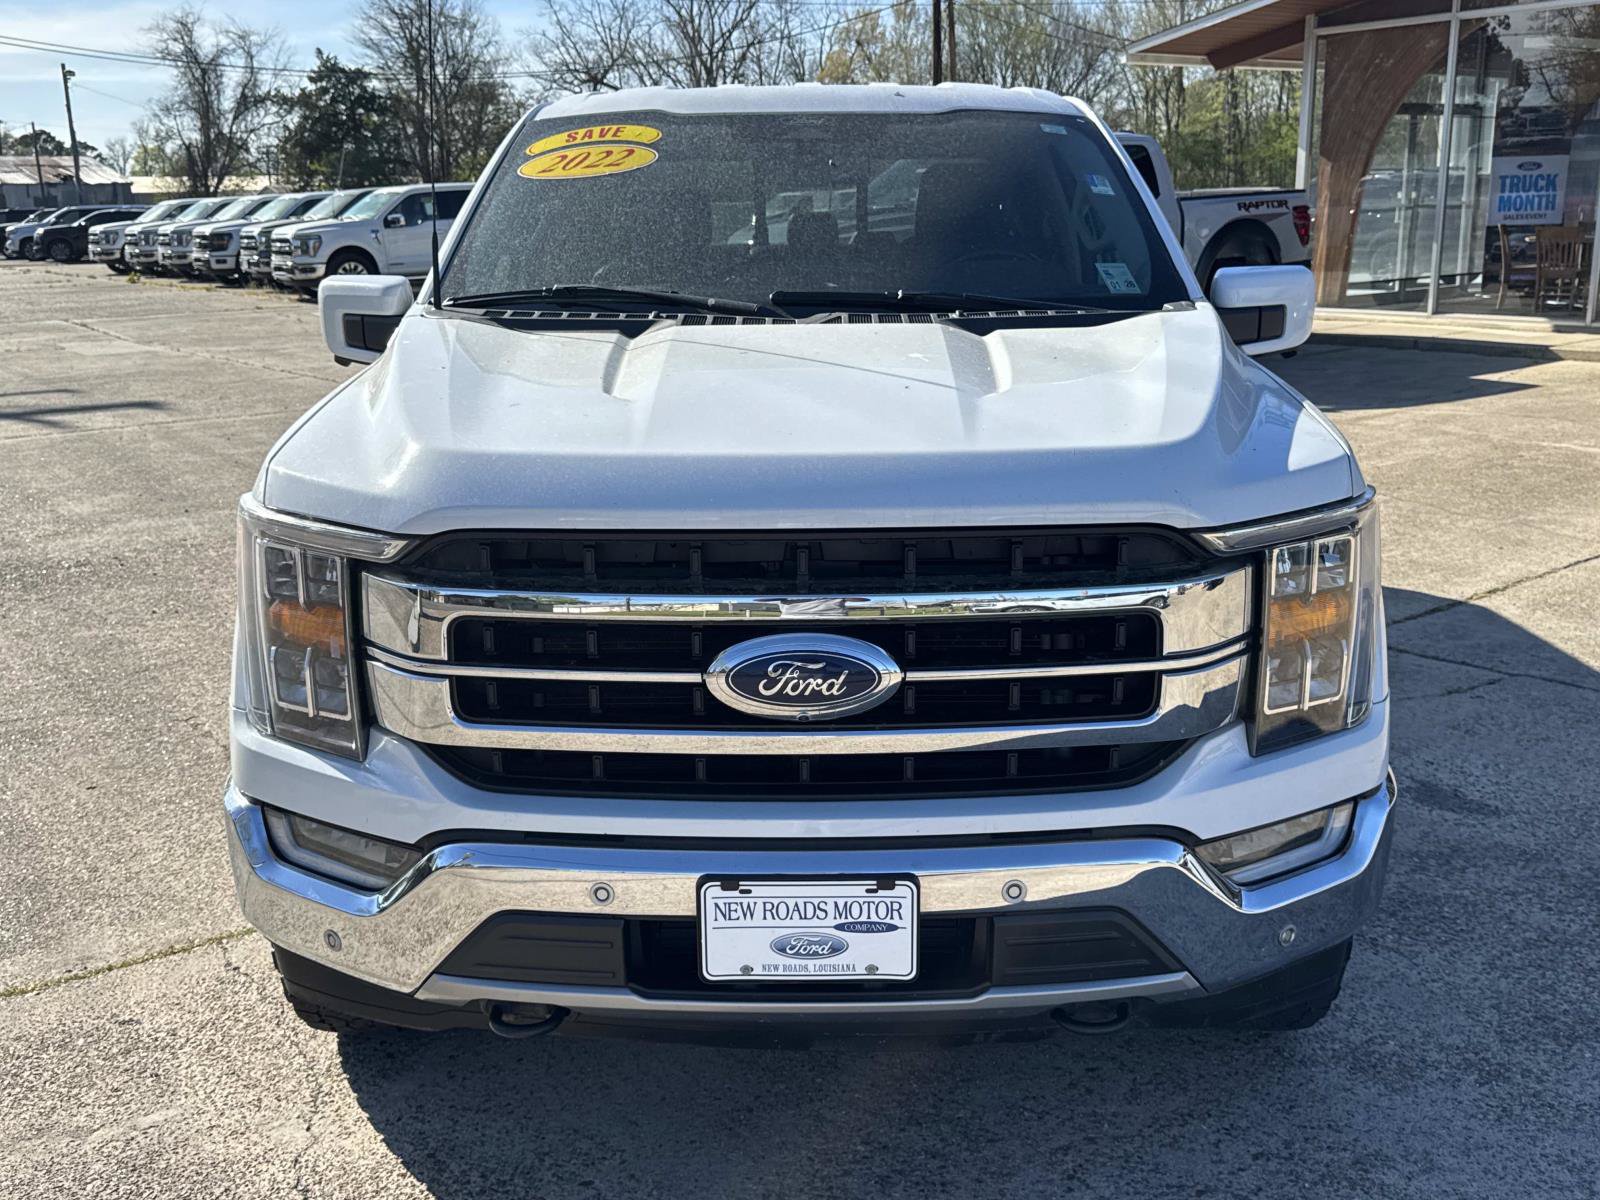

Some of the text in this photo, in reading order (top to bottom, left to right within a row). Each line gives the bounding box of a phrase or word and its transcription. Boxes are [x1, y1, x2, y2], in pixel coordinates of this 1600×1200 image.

[565, 126, 627, 143] SAVE
[537, 148, 636, 174] 2022
[1499, 174, 1558, 193] TRUCK
[1237, 200, 1290, 213] RAPTOR
[1498, 193, 1557, 213] MONTH
[758, 660, 849, 696] Ford
[713, 900, 903, 921] NEW ROADS MOTOR
[844, 923, 889, 932] COMPANY
[786, 936, 832, 955] Ford
[761, 963, 857, 974] NEW ROADS, LOUISIANA
